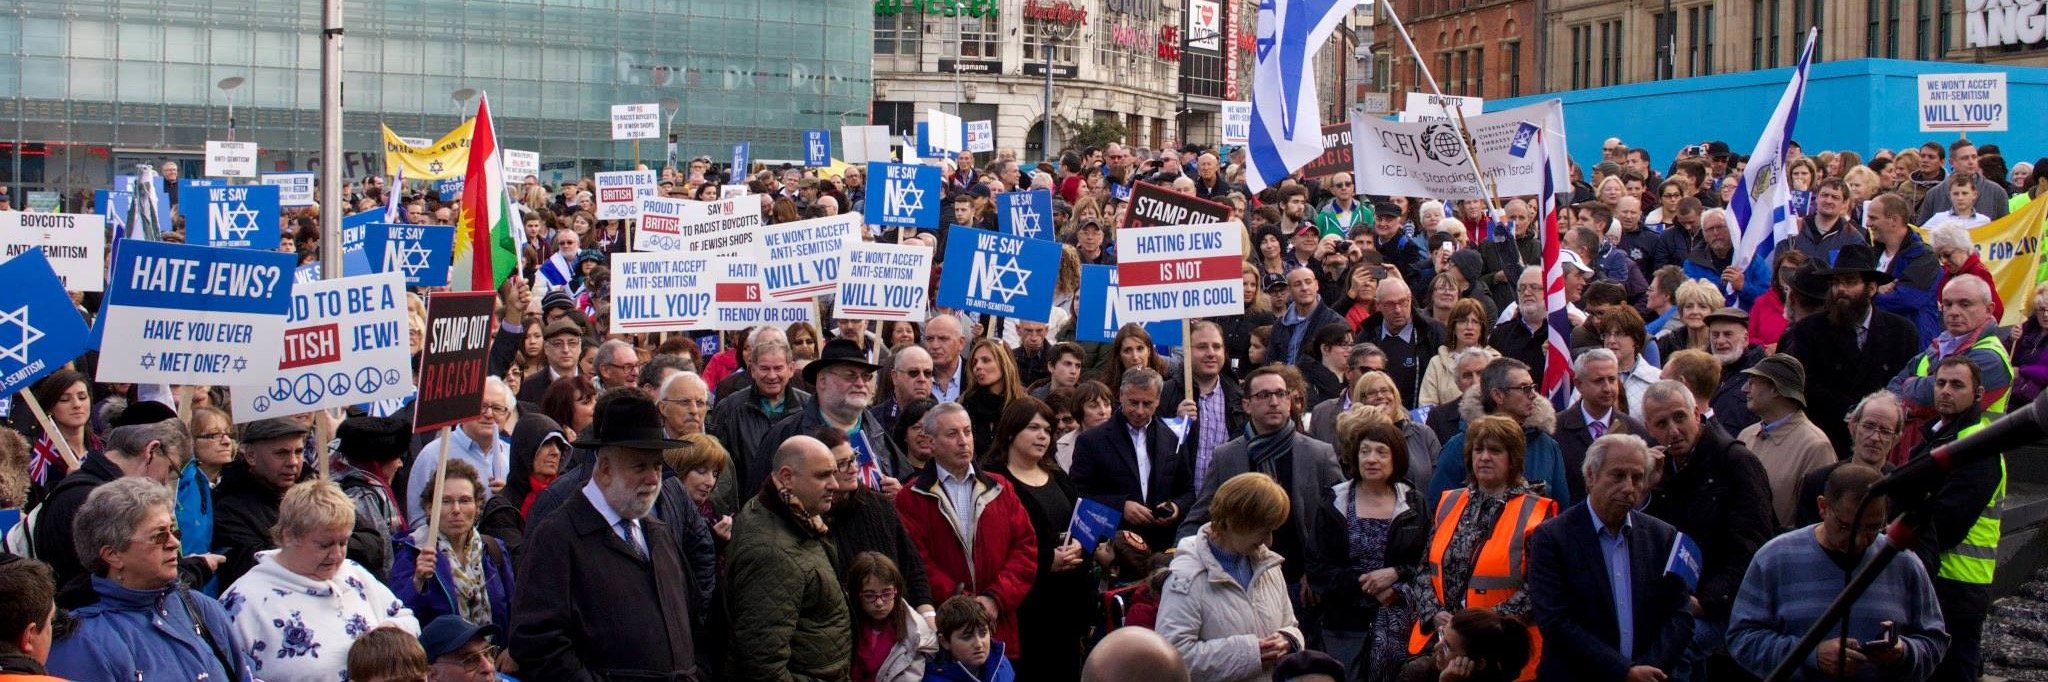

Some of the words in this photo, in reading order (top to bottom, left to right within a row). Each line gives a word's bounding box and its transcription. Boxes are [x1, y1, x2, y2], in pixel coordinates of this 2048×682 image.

[1927, 80, 1938, 90] WE
[1941, 80, 1965, 90] WON'T
[1968, 79, 1997, 90] ACCEPT
[1930, 90, 1990, 100] ANTI-SEMITISM
[1924, 104, 1960, 122] WILL
[1964, 104, 2002, 121] YOU?
[1226, 124, 1246, 138] WILL
[599, 176, 622, 186] PROUD
[625, 175, 634, 185] TO
[636, 175, 645, 185] BE
[646, 174, 652, 184] A
[887, 166, 900, 179] WE
[901, 166, 917, 179] SAY
[1423, 172, 1476, 184] Standing
[1509, 162, 1534, 176] Israel
[210, 188, 226, 201] WE
[228, 188, 248, 200] SAY
[602, 189, 632, 201] BRITISH
[1010, 194, 1020, 205] WE
[1021, 193, 1032, 204] SAY
[644, 201, 672, 213] PROUD
[708, 204, 722, 216] SAY
[723, 202, 734, 212] NO
[1135, 196, 1187, 225] STAMP
[21, 214, 75, 228] BOYCOTTS
[683, 225, 693, 236] TO
[696, 221, 721, 235] RACIST
[723, 215, 759, 230] BOYCOTTS
[389, 227, 404, 240] WE
[406, 228, 424, 240] SAY
[700, 236, 728, 250] JEWISH
[730, 232, 752, 246] SHOPS
[765, 233, 779, 247] WE
[782, 228, 812, 244] WON'T
[816, 222, 850, 238] ACCEPT
[770, 239, 842, 260] ANTI-SEMITISM
[978, 233, 998, 251] WE
[999, 236, 1024, 256] SAY
[1137, 234, 1184, 254] HATING
[1188, 232, 1222, 251] JEWS
[1989, 242, 2013, 260] FOR
[623, 263, 637, 274] WE
[640, 261, 669, 274] WON'T
[672, 260, 707, 272] ACCEPT
[850, 251, 863, 263] WE
[865, 251, 890, 265] WON'T
[892, 254, 923, 267] ACCEPT
[130, 255, 200, 294] HATE
[201, 263, 281, 299] JEWS?
[764, 262, 810, 290] WILL
[813, 257, 840, 282] YO
[851, 266, 913, 280] ANTI-SEMITISM
[1160, 262, 1172, 281] IS
[1176, 261, 1202, 280] NOT
[626, 275, 697, 289] ANTI-SEMITISM
[314, 292, 341, 318] TO
[348, 287, 375, 314] BE
[381, 283, 395, 309] A
[746, 286, 756, 300] IS
[842, 283, 878, 306] WILL
[884, 284, 923, 309] YOU?
[1127, 291, 1178, 311] TRENDY
[1183, 290, 1200, 307] OR
[1203, 287, 1236, 305] COOL
[617, 295, 660, 319] WILL
[666, 292, 711, 318] YOU?
[718, 307, 761, 322] TRENDY
[764, 308, 778, 322] OR
[782, 308, 809, 321] COOL
[974, 300, 1015, 313] ANTI-SEMITISM
[143, 319, 184, 342] HAVE
[187, 322, 213, 343] YOU
[216, 324, 253, 344] EVER
[430, 316, 468, 354] STAMP
[467, 315, 489, 350] OUT
[281, 330, 335, 363] TISH
[351, 322, 400, 352] JEW!
[159, 352, 190, 372] MET
[193, 354, 230, 373] ONE?
[425, 358, 482, 401] RACISM
